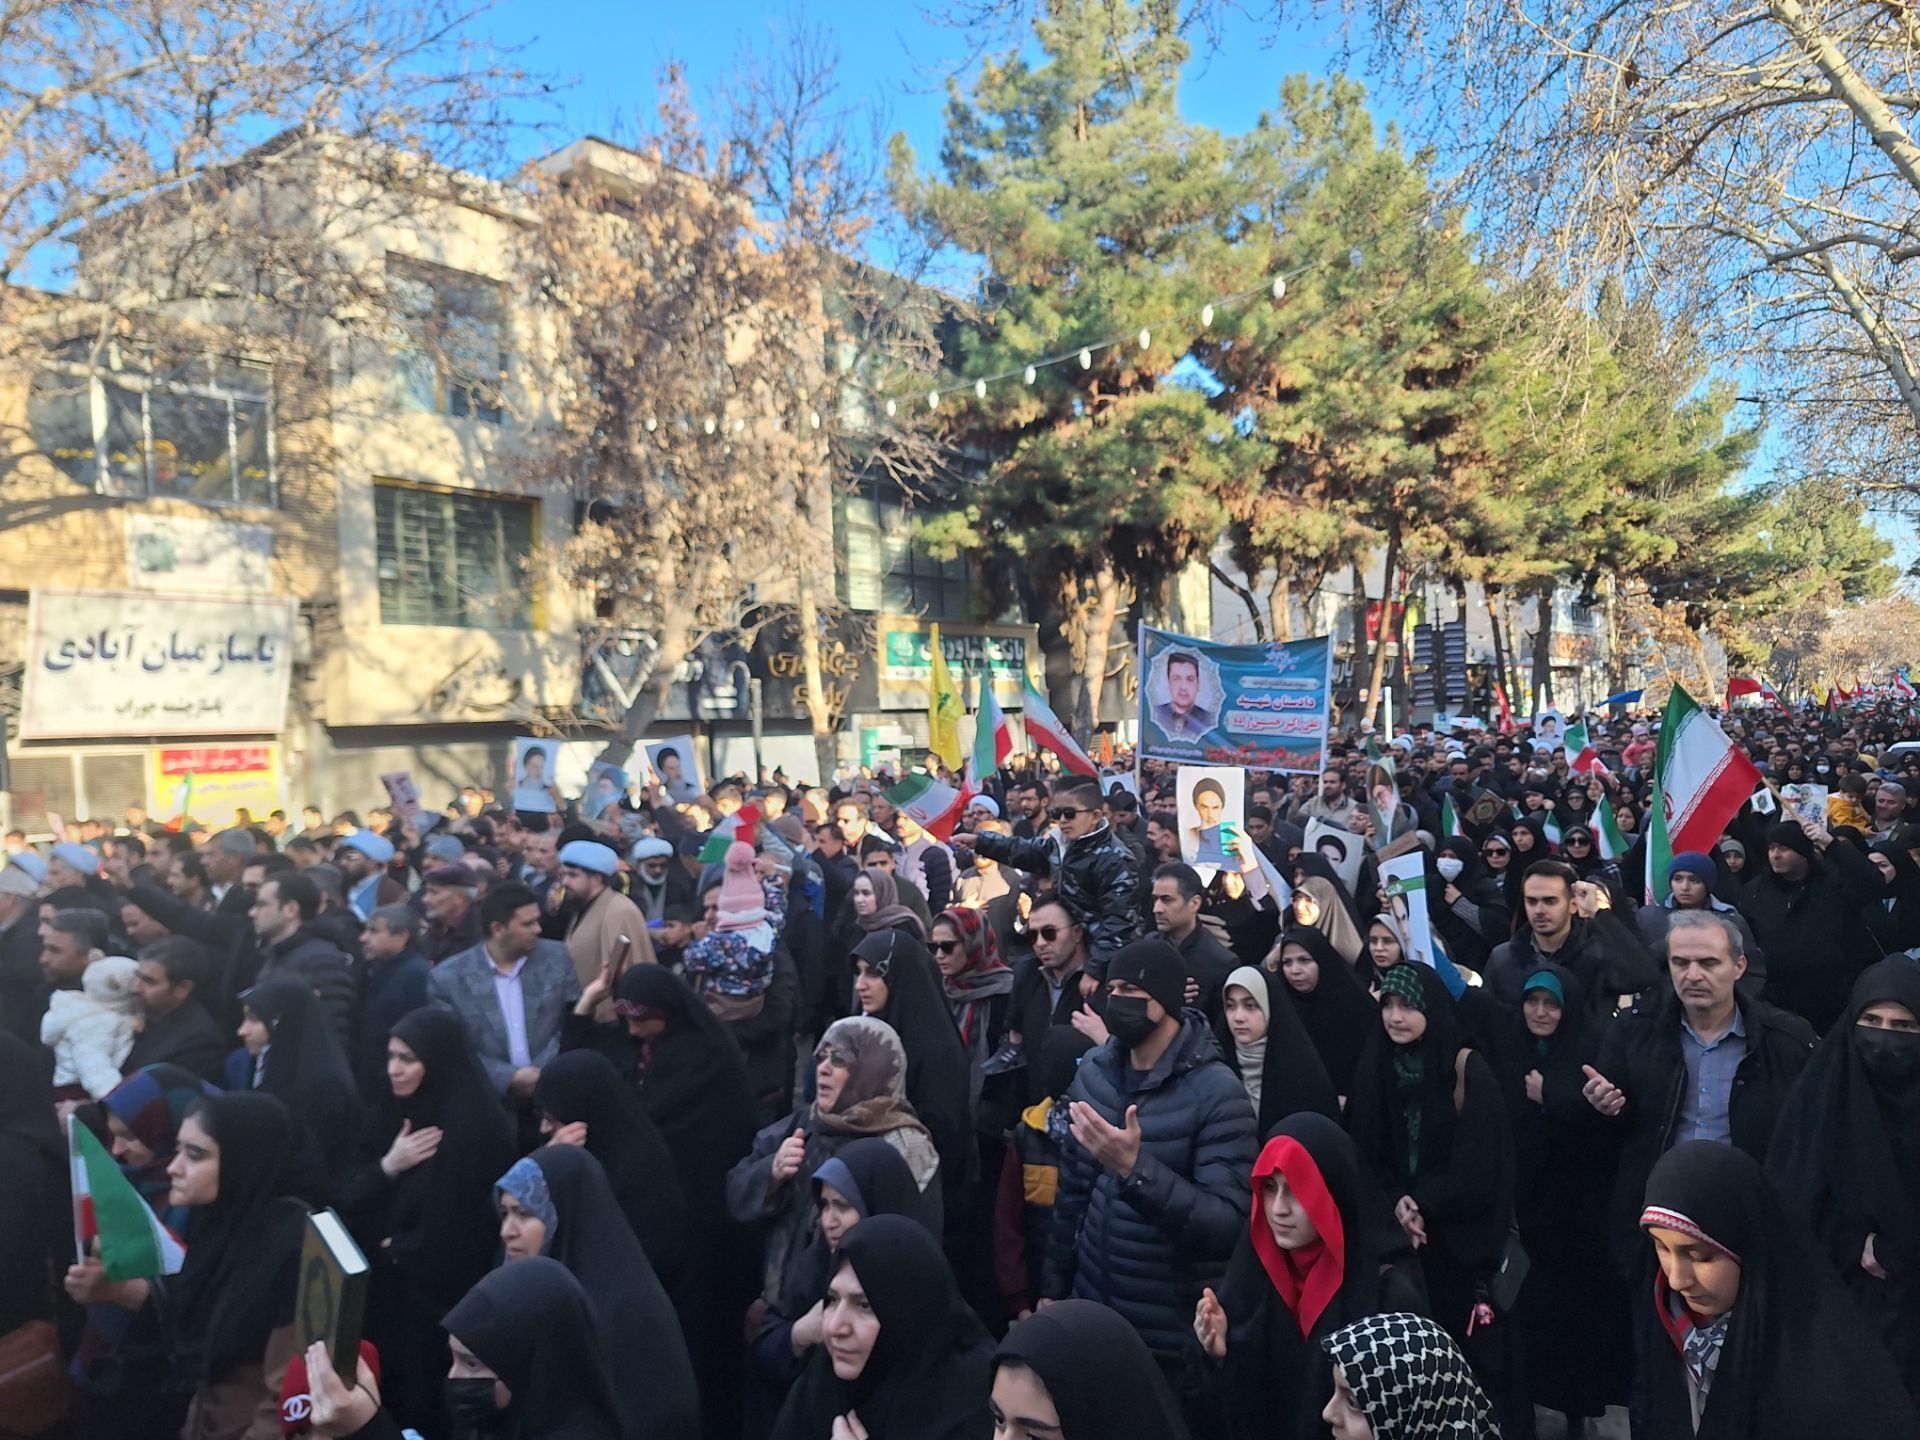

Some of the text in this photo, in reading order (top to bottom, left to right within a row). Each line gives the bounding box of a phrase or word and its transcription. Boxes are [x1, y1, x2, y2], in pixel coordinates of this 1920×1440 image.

[43, 622, 275, 675] پاساژ میان آبادی
[1236, 693, 1316, 710] دادستان شهید
[1280, 717, 1300, 732] اکبر
[1299, 717, 1319, 732] علی
